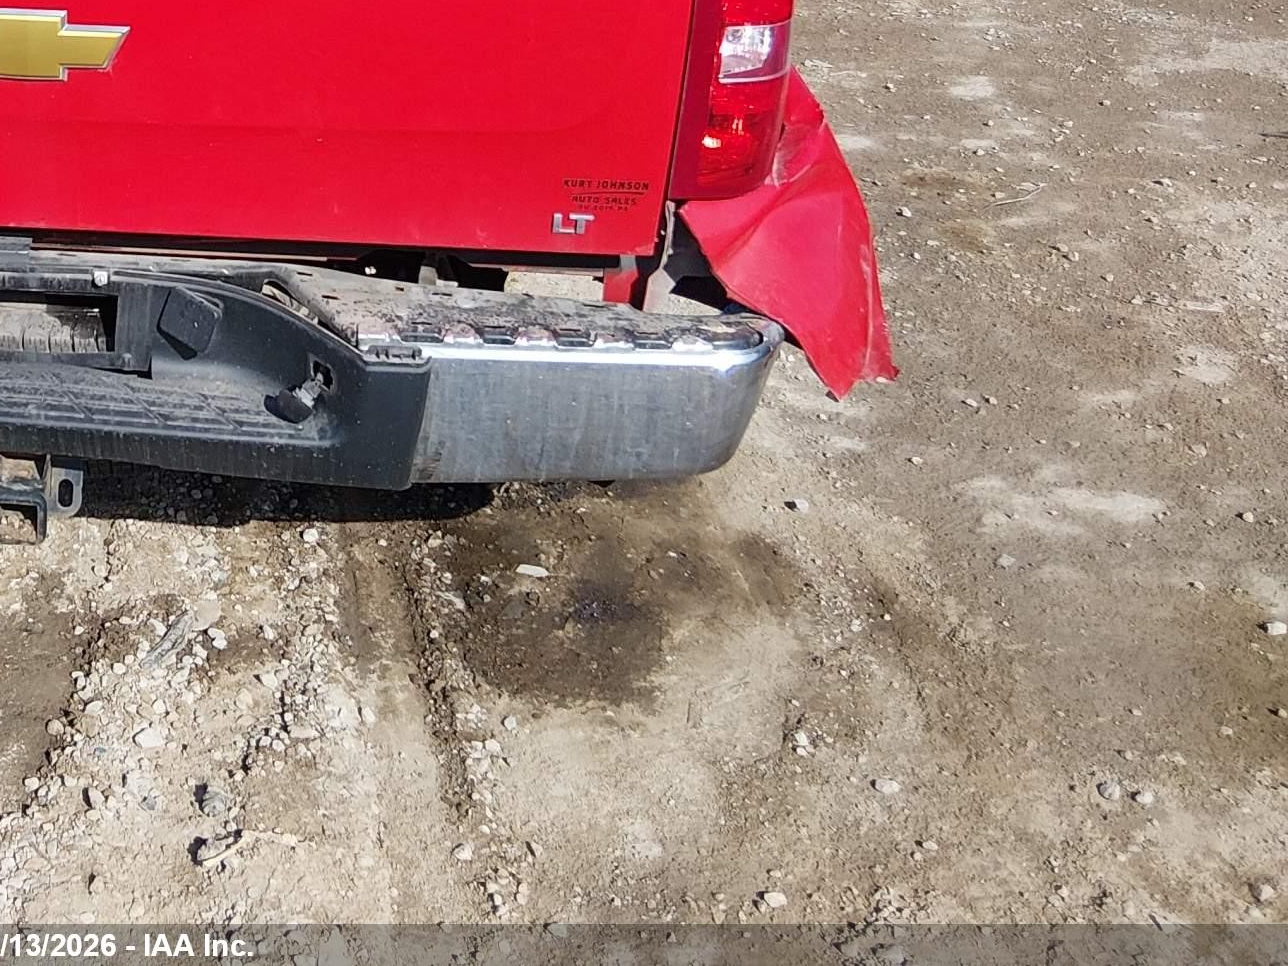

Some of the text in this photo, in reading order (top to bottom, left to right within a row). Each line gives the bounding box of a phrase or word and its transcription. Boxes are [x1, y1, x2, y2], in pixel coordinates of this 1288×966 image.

[563, 179, 649, 191] KURT JOHNSON
[571, 195, 638, 206] AUTO SALES
[552, 212, 596, 235] LT
